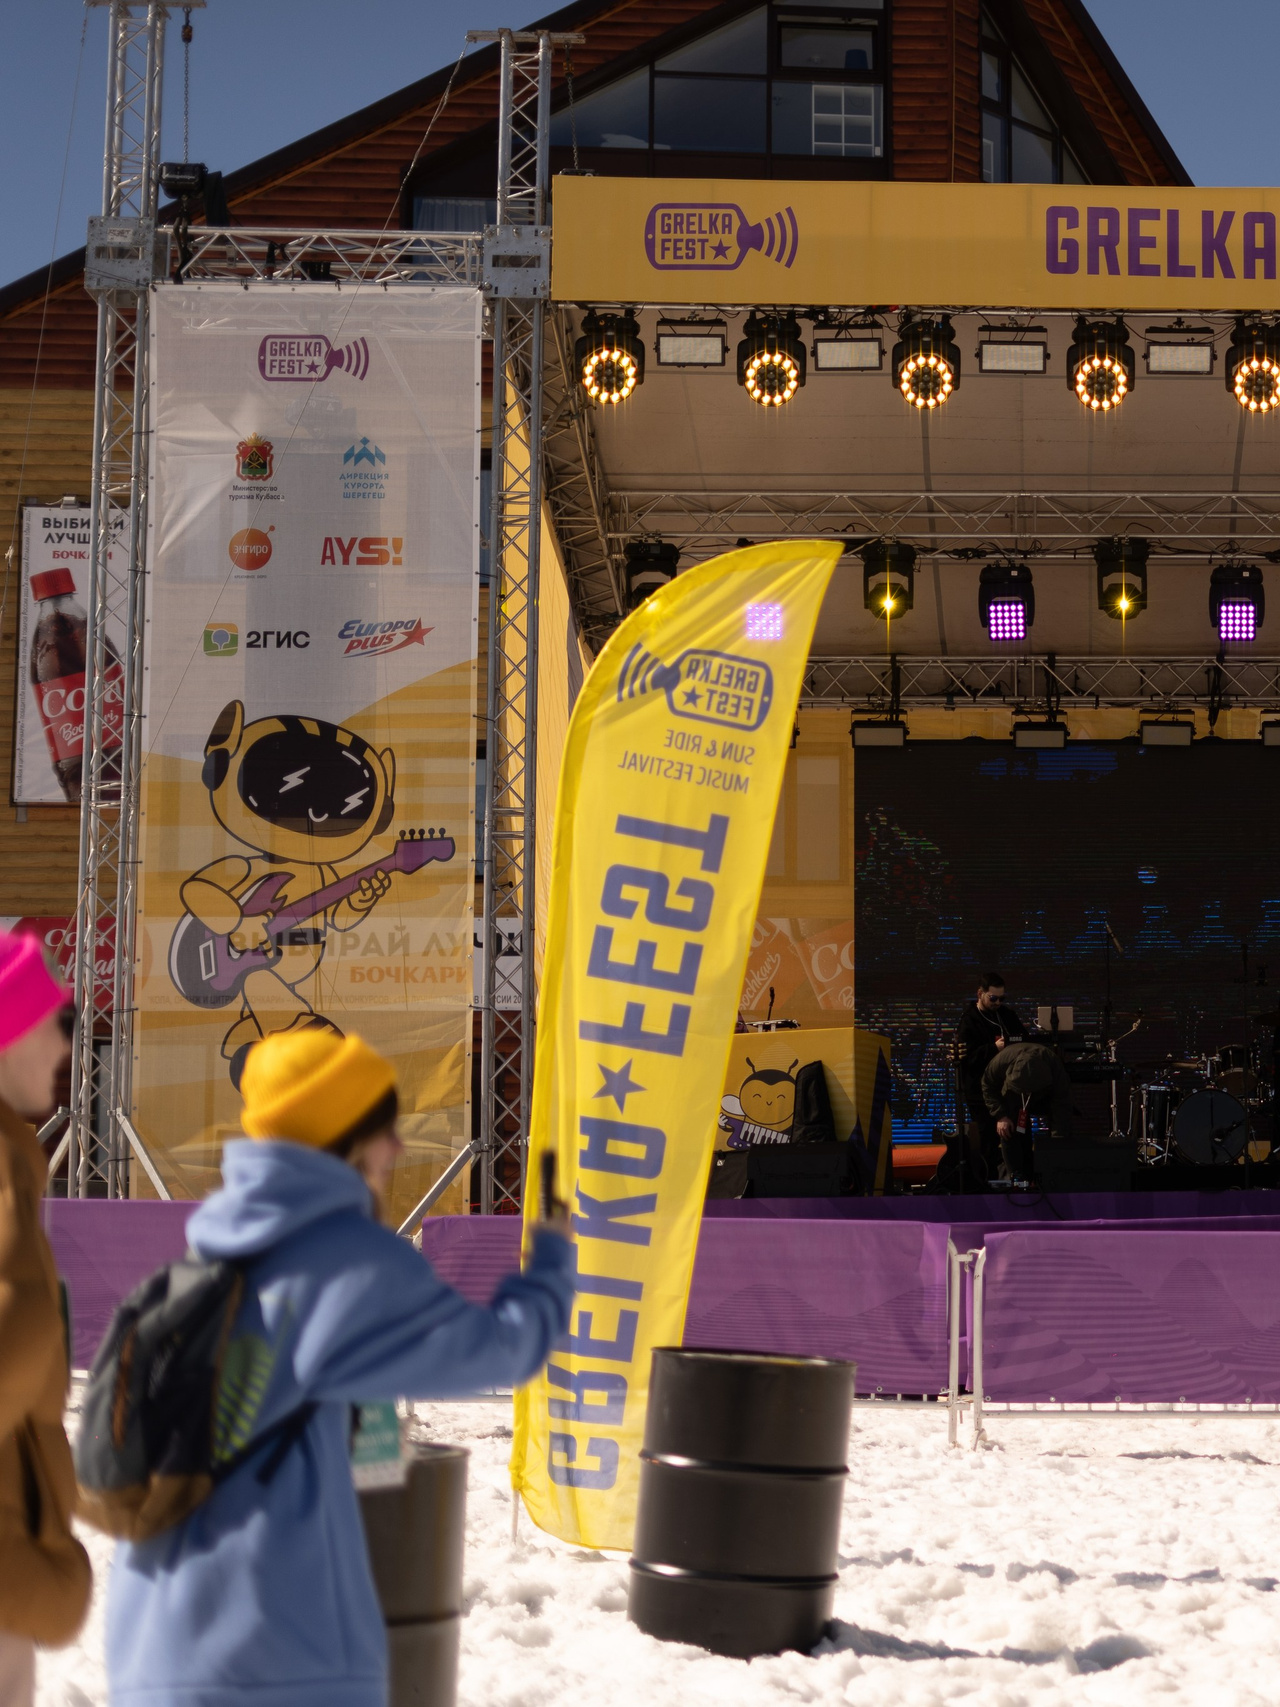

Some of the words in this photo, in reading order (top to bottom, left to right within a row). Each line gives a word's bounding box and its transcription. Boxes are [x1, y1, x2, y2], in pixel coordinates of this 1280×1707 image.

[660, 213, 733, 235] GRELKA
[660, 238, 709, 260] FEST
[269, 341, 322, 357] GRELKA
[269, 359, 305, 375] FEST
[339, 473, 389, 481] ДИРЕКЦИЯ
[232, 484, 278, 492] Министерство
[344, 482, 385, 490] КУРОРТА
[233, 544, 268, 557] энгиро
[320, 537, 403, 565] AYS!
[246, 630, 311, 649] 2ГИС
[42, 680, 123, 718] Coa
[739, 951, 780, 1011] ochkari
